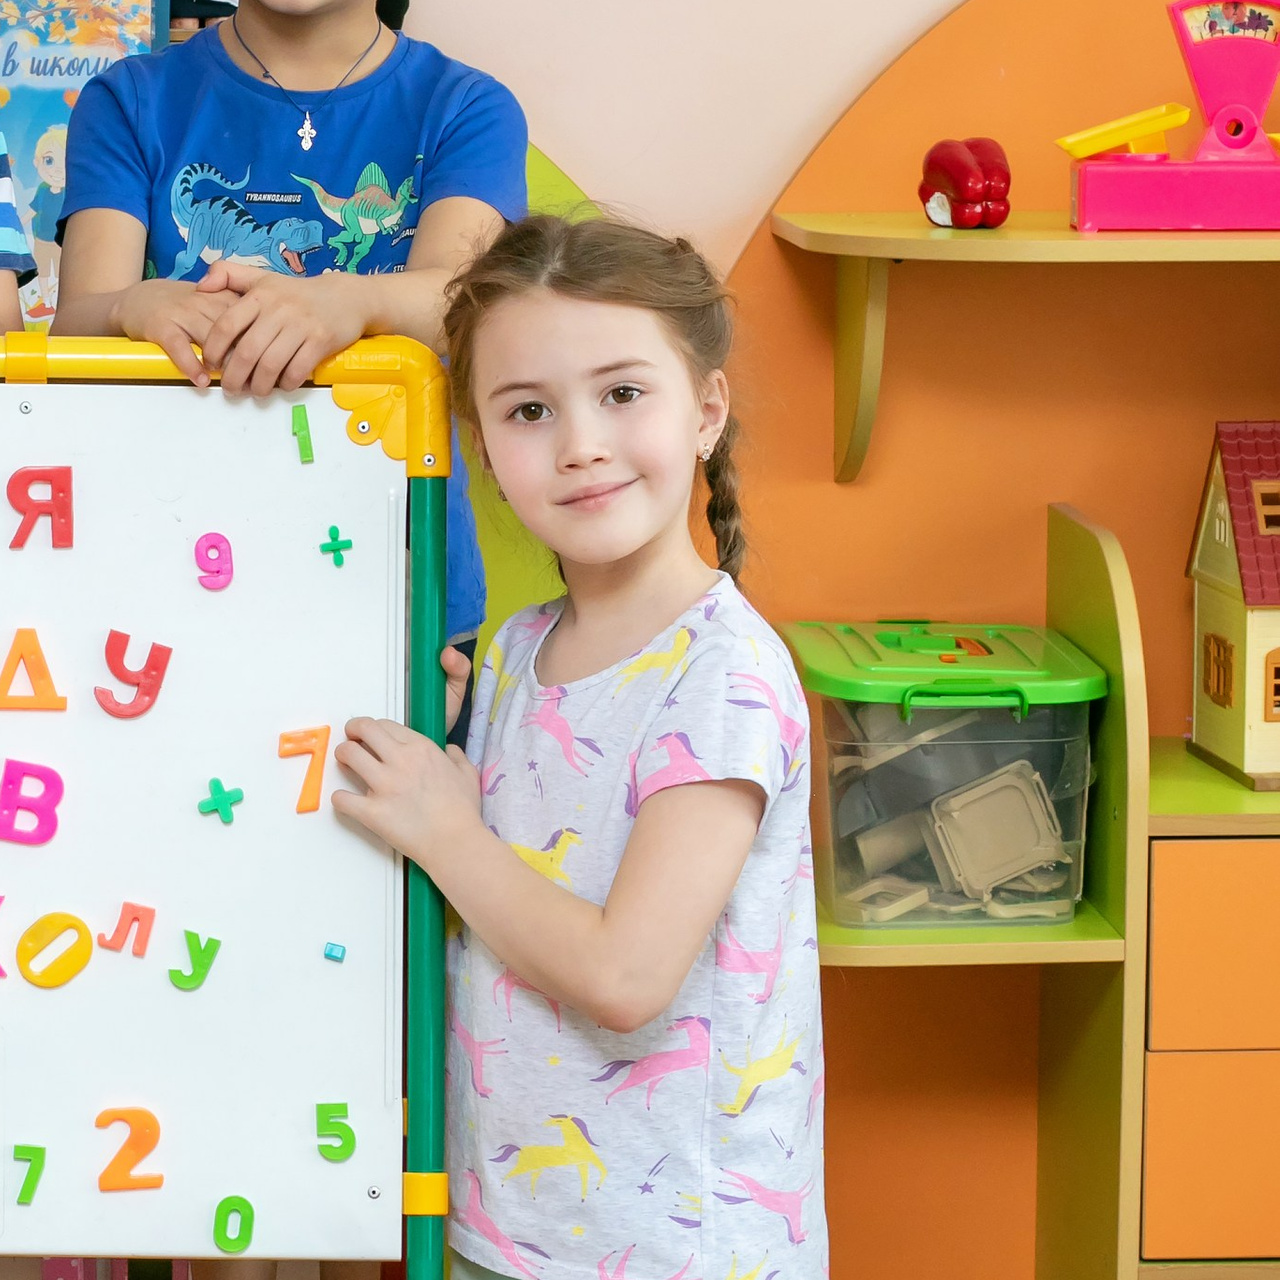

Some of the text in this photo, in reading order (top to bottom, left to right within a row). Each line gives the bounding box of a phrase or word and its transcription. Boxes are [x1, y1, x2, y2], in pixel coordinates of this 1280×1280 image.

[2, 41, 20, 77] в
[245, 193, 302, 203] TYRANNOSAURUS
[7, 466, 73, 549] Я
[195, 533, 233, 590] 9
[279, 725, 331, 814] 7
[95, 1108, 164, 1192] 2
[316, 1103, 356, 1162] 5
[14, 1145, 46, 1204] 7
